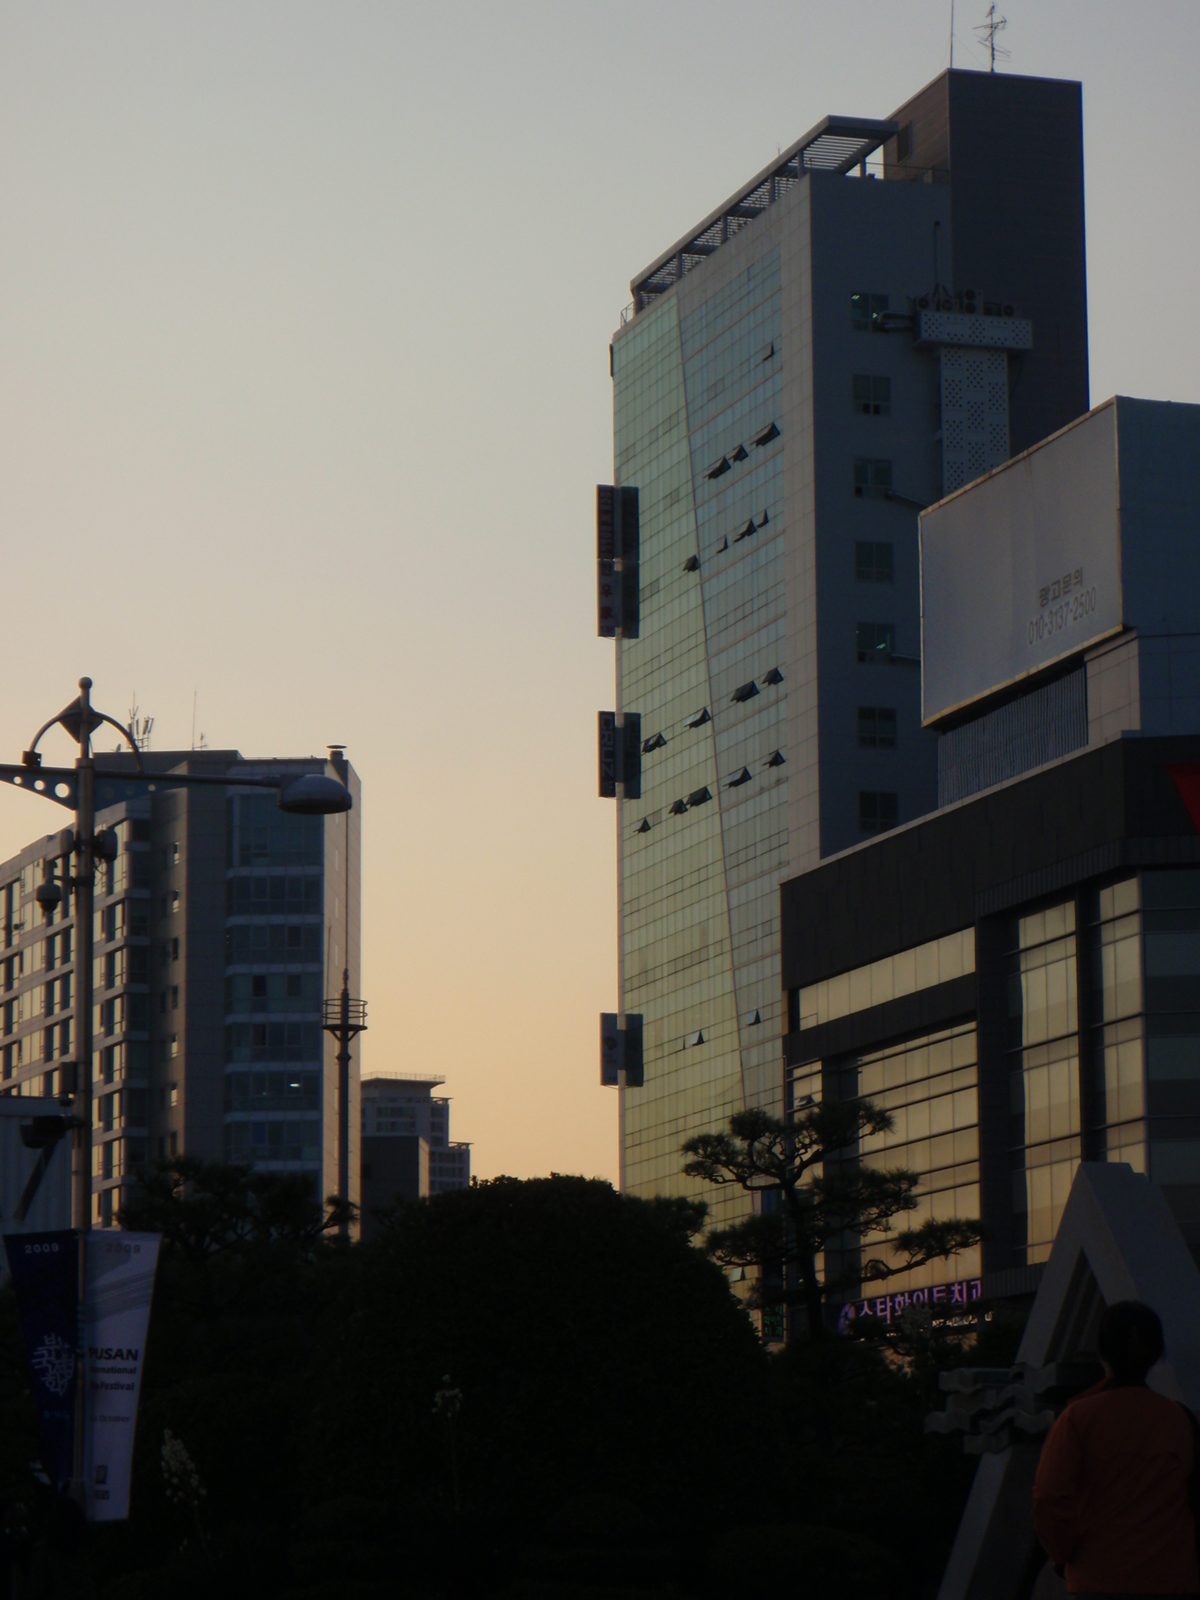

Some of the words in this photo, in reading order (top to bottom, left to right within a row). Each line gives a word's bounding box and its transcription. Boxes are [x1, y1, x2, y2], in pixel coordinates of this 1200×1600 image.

[1039, 567, 1083, 607] 광고문의
[24, 1241, 60, 1255] 2009
[105, 1243, 142, 1255] 2009
[88, 1346, 139, 1361] PUSAN
